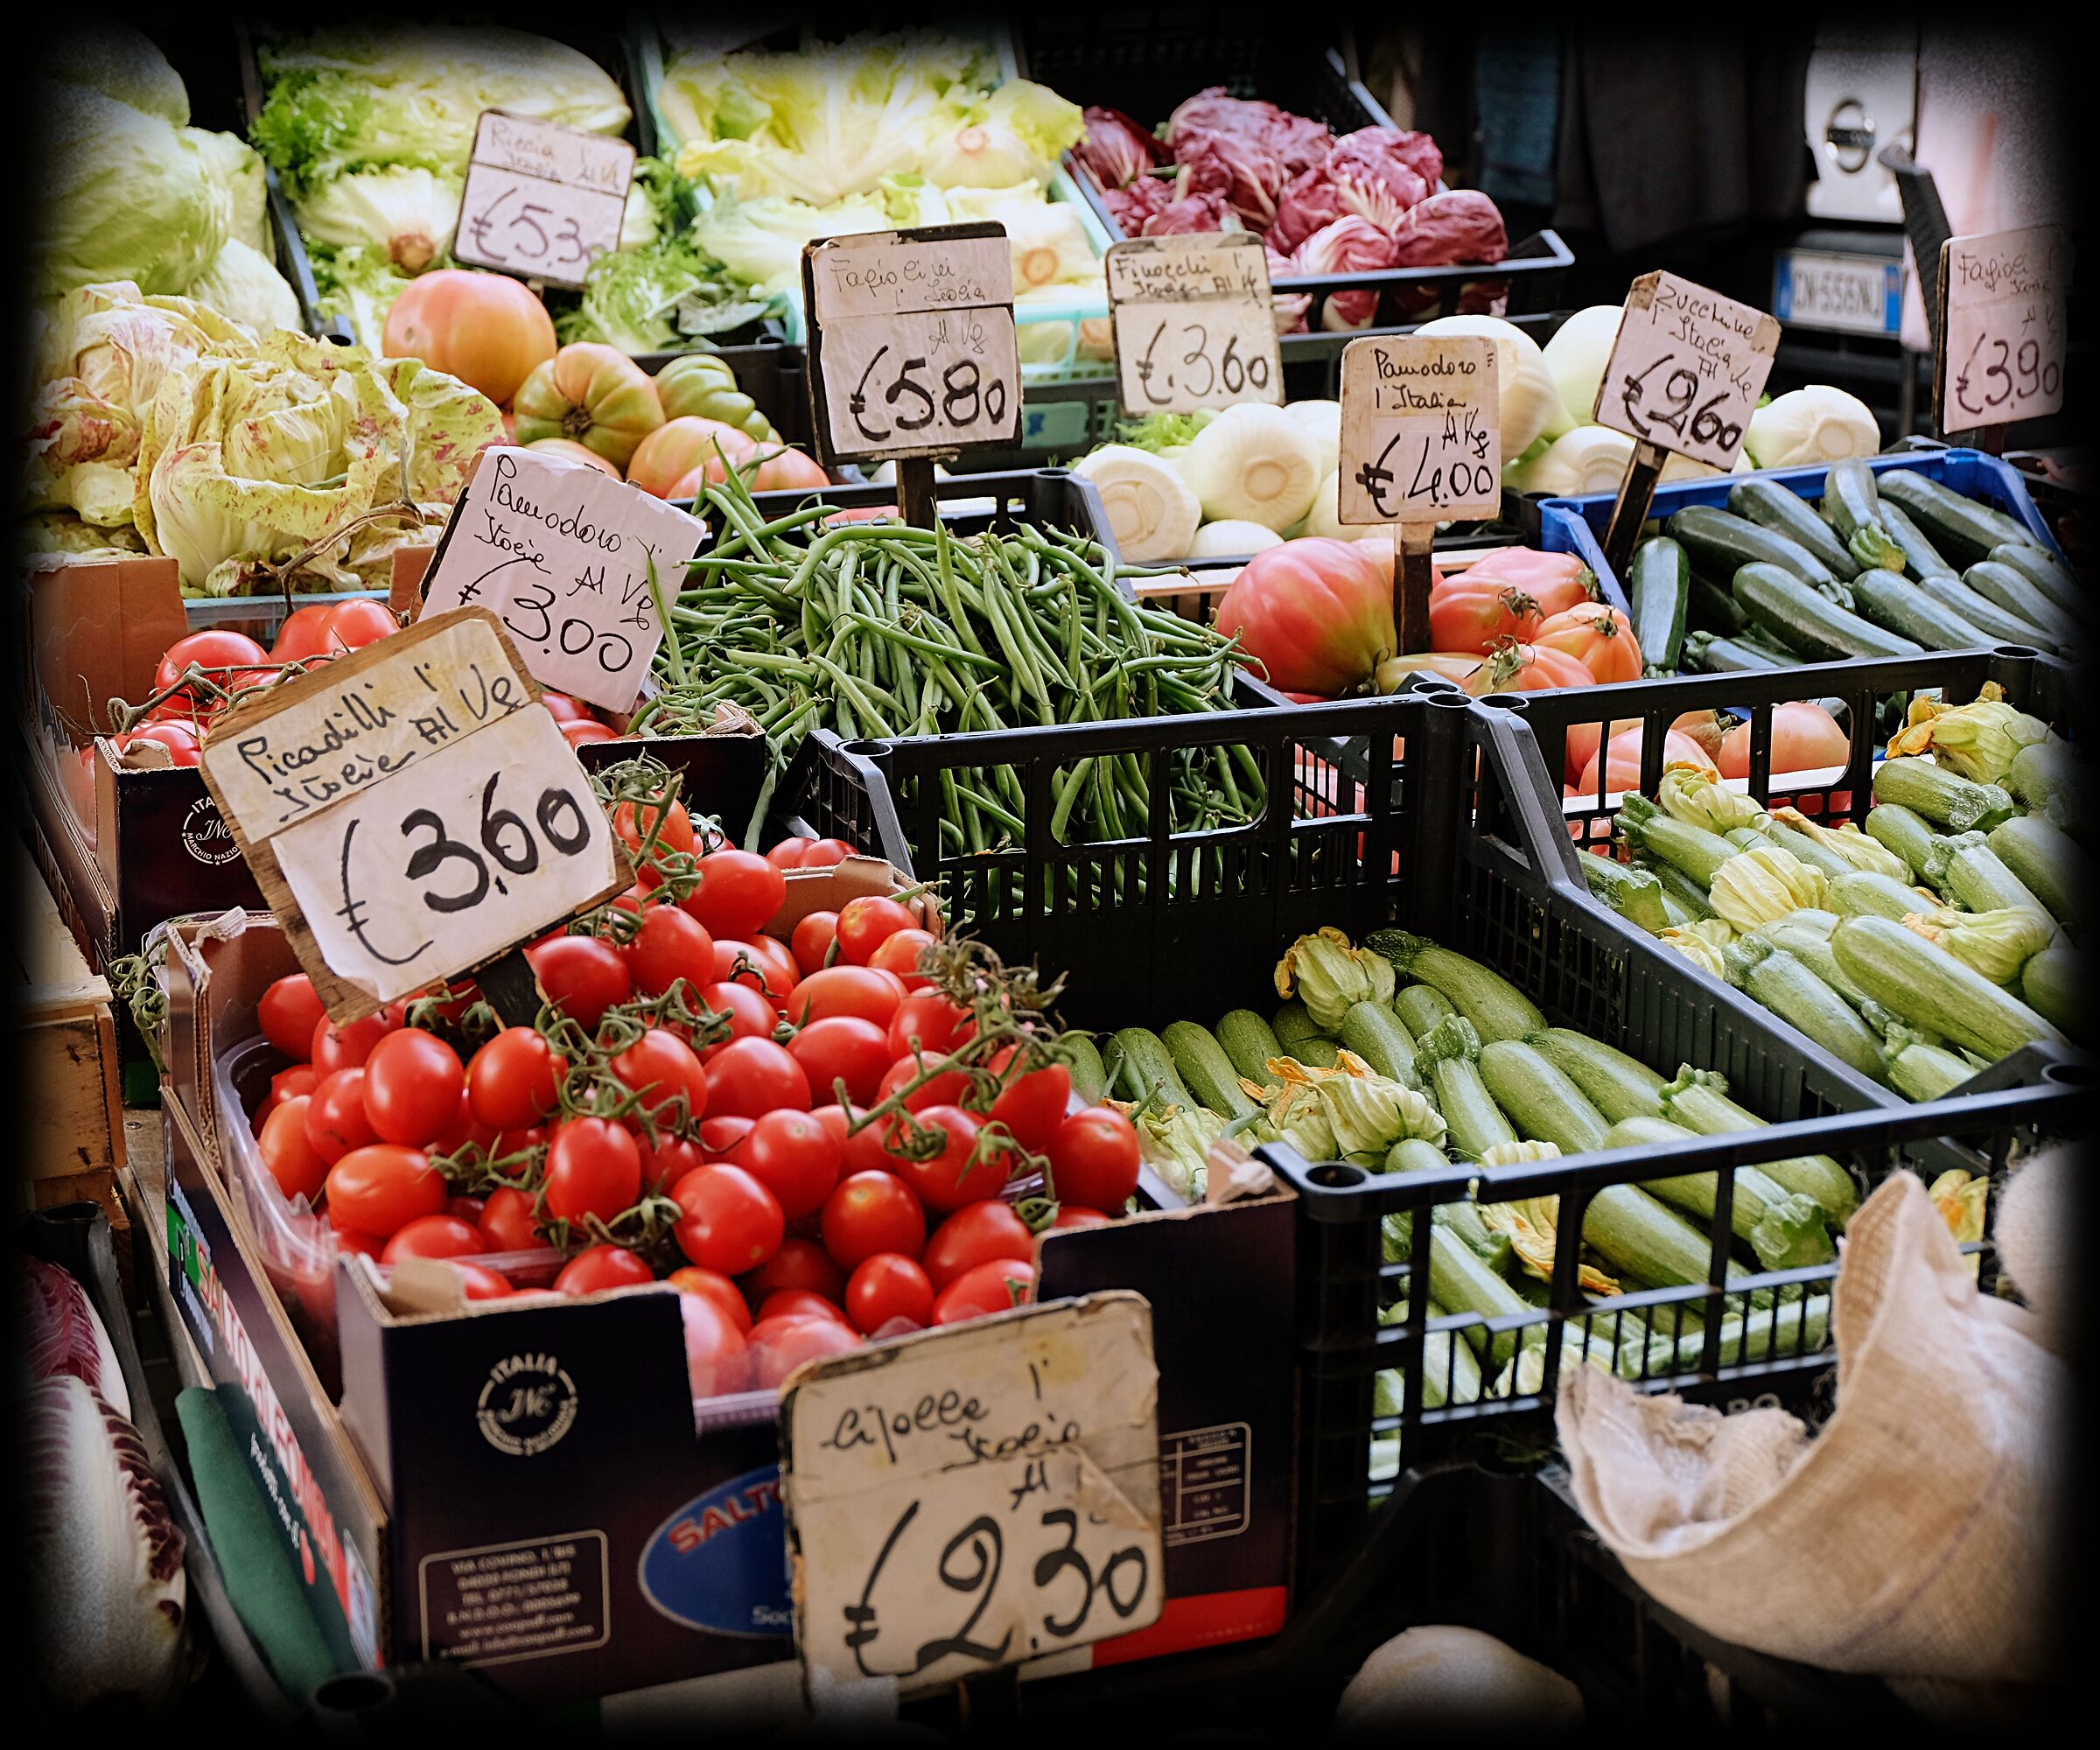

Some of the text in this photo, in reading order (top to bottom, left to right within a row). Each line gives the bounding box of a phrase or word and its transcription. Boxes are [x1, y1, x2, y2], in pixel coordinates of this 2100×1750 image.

[1656, 283, 1754, 340] Zucchine
[1374, 347, 1477, 380] Pomodoro
[1391, 383, 1467, 410] Italia
[489, 453, 623, 553] Pomodoro
[186, 832, 242, 861] MARCHIO NAZIO
[490, 1352, 558, 1385] ITALIA
